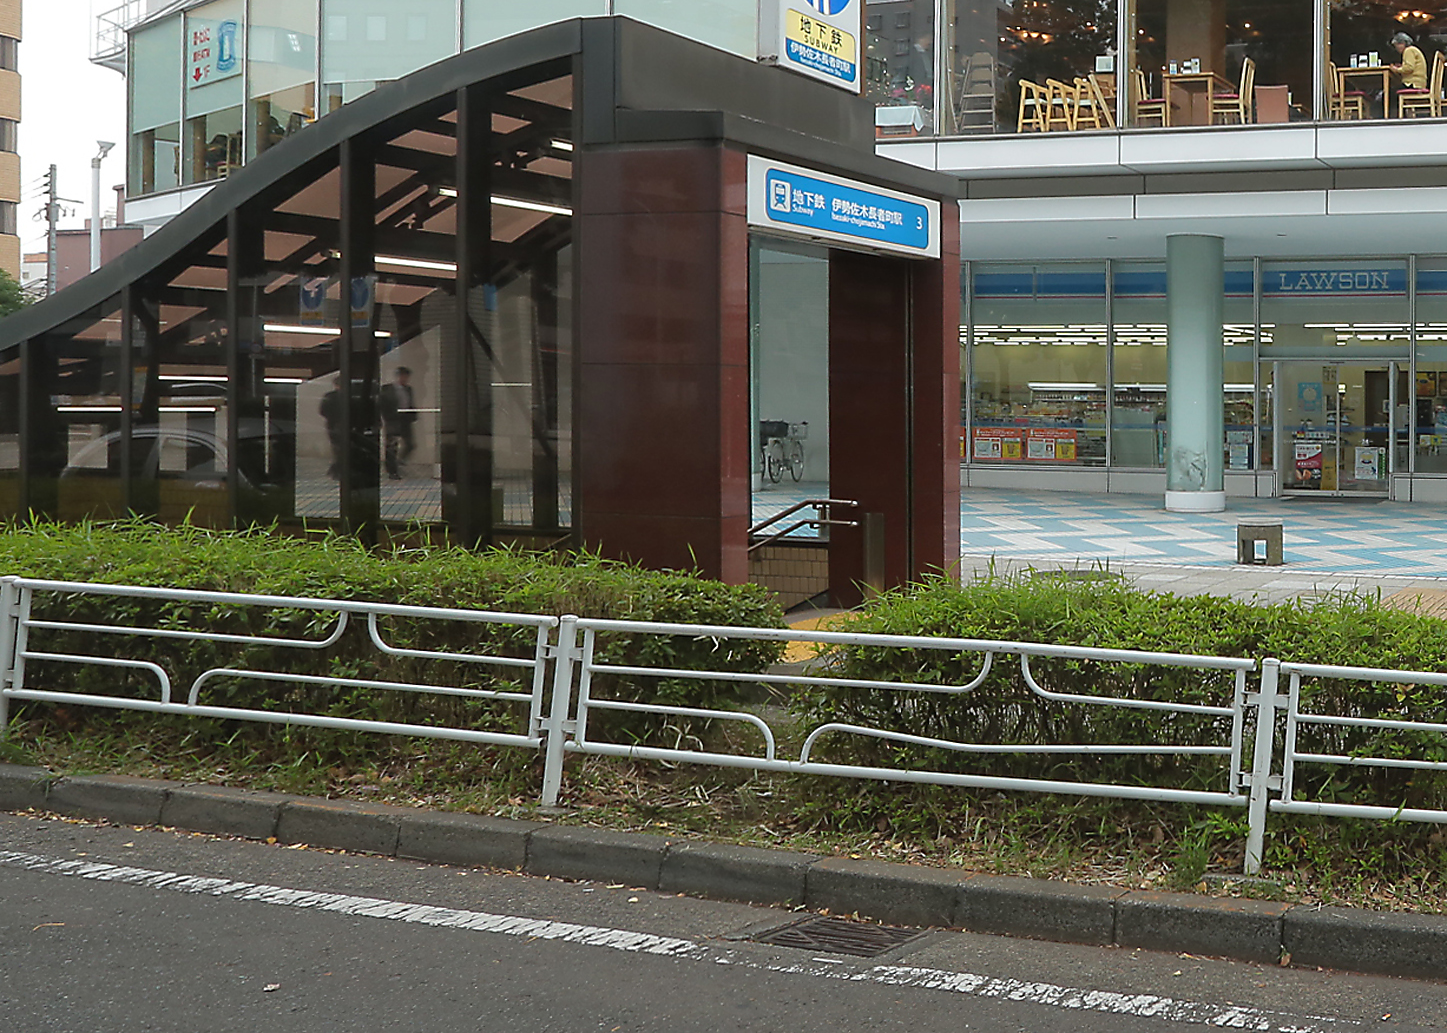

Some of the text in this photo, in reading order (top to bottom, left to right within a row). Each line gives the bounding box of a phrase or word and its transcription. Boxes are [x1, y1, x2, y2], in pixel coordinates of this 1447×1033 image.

[800, 15, 843, 48] 地下鉄
[803, 34, 839, 55] SUBWAY
[792, 188, 903, 226] 地下鉄 伊勢佐木長者町駅
[792, 203, 814, 218] Subway
[916, 216, 924, 230] 3
[1279, 271, 1389, 291] LAWSON
